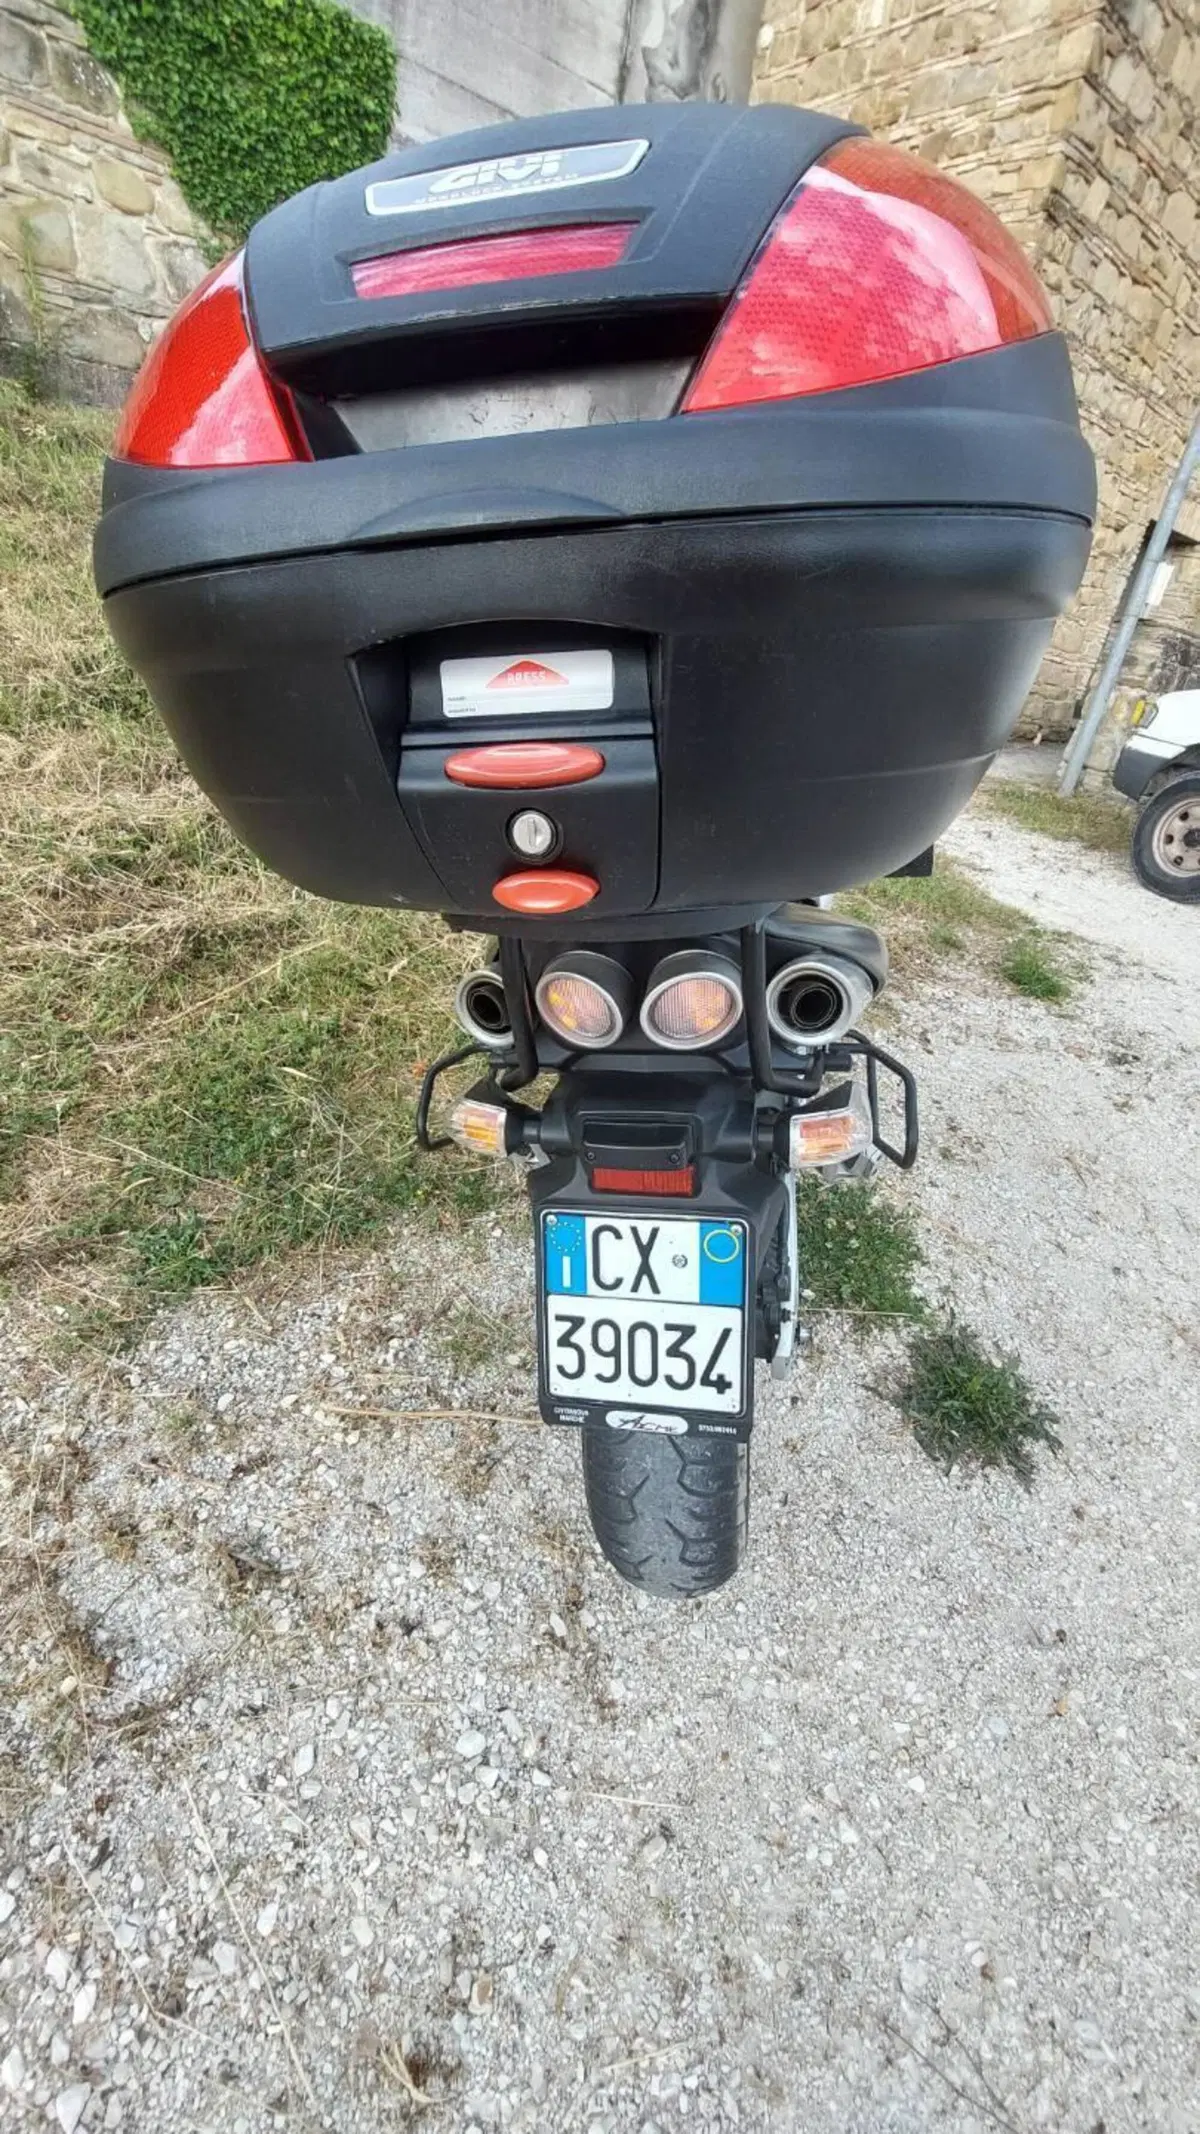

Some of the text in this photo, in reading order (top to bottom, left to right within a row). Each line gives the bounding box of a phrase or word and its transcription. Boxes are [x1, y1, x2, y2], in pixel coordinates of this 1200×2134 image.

[428, 154, 563, 194] GIVI
[507, 670, 547, 685] PRESS
[591, 1224, 661, 1295] CX
[554, 1313, 733, 1395] 39034
